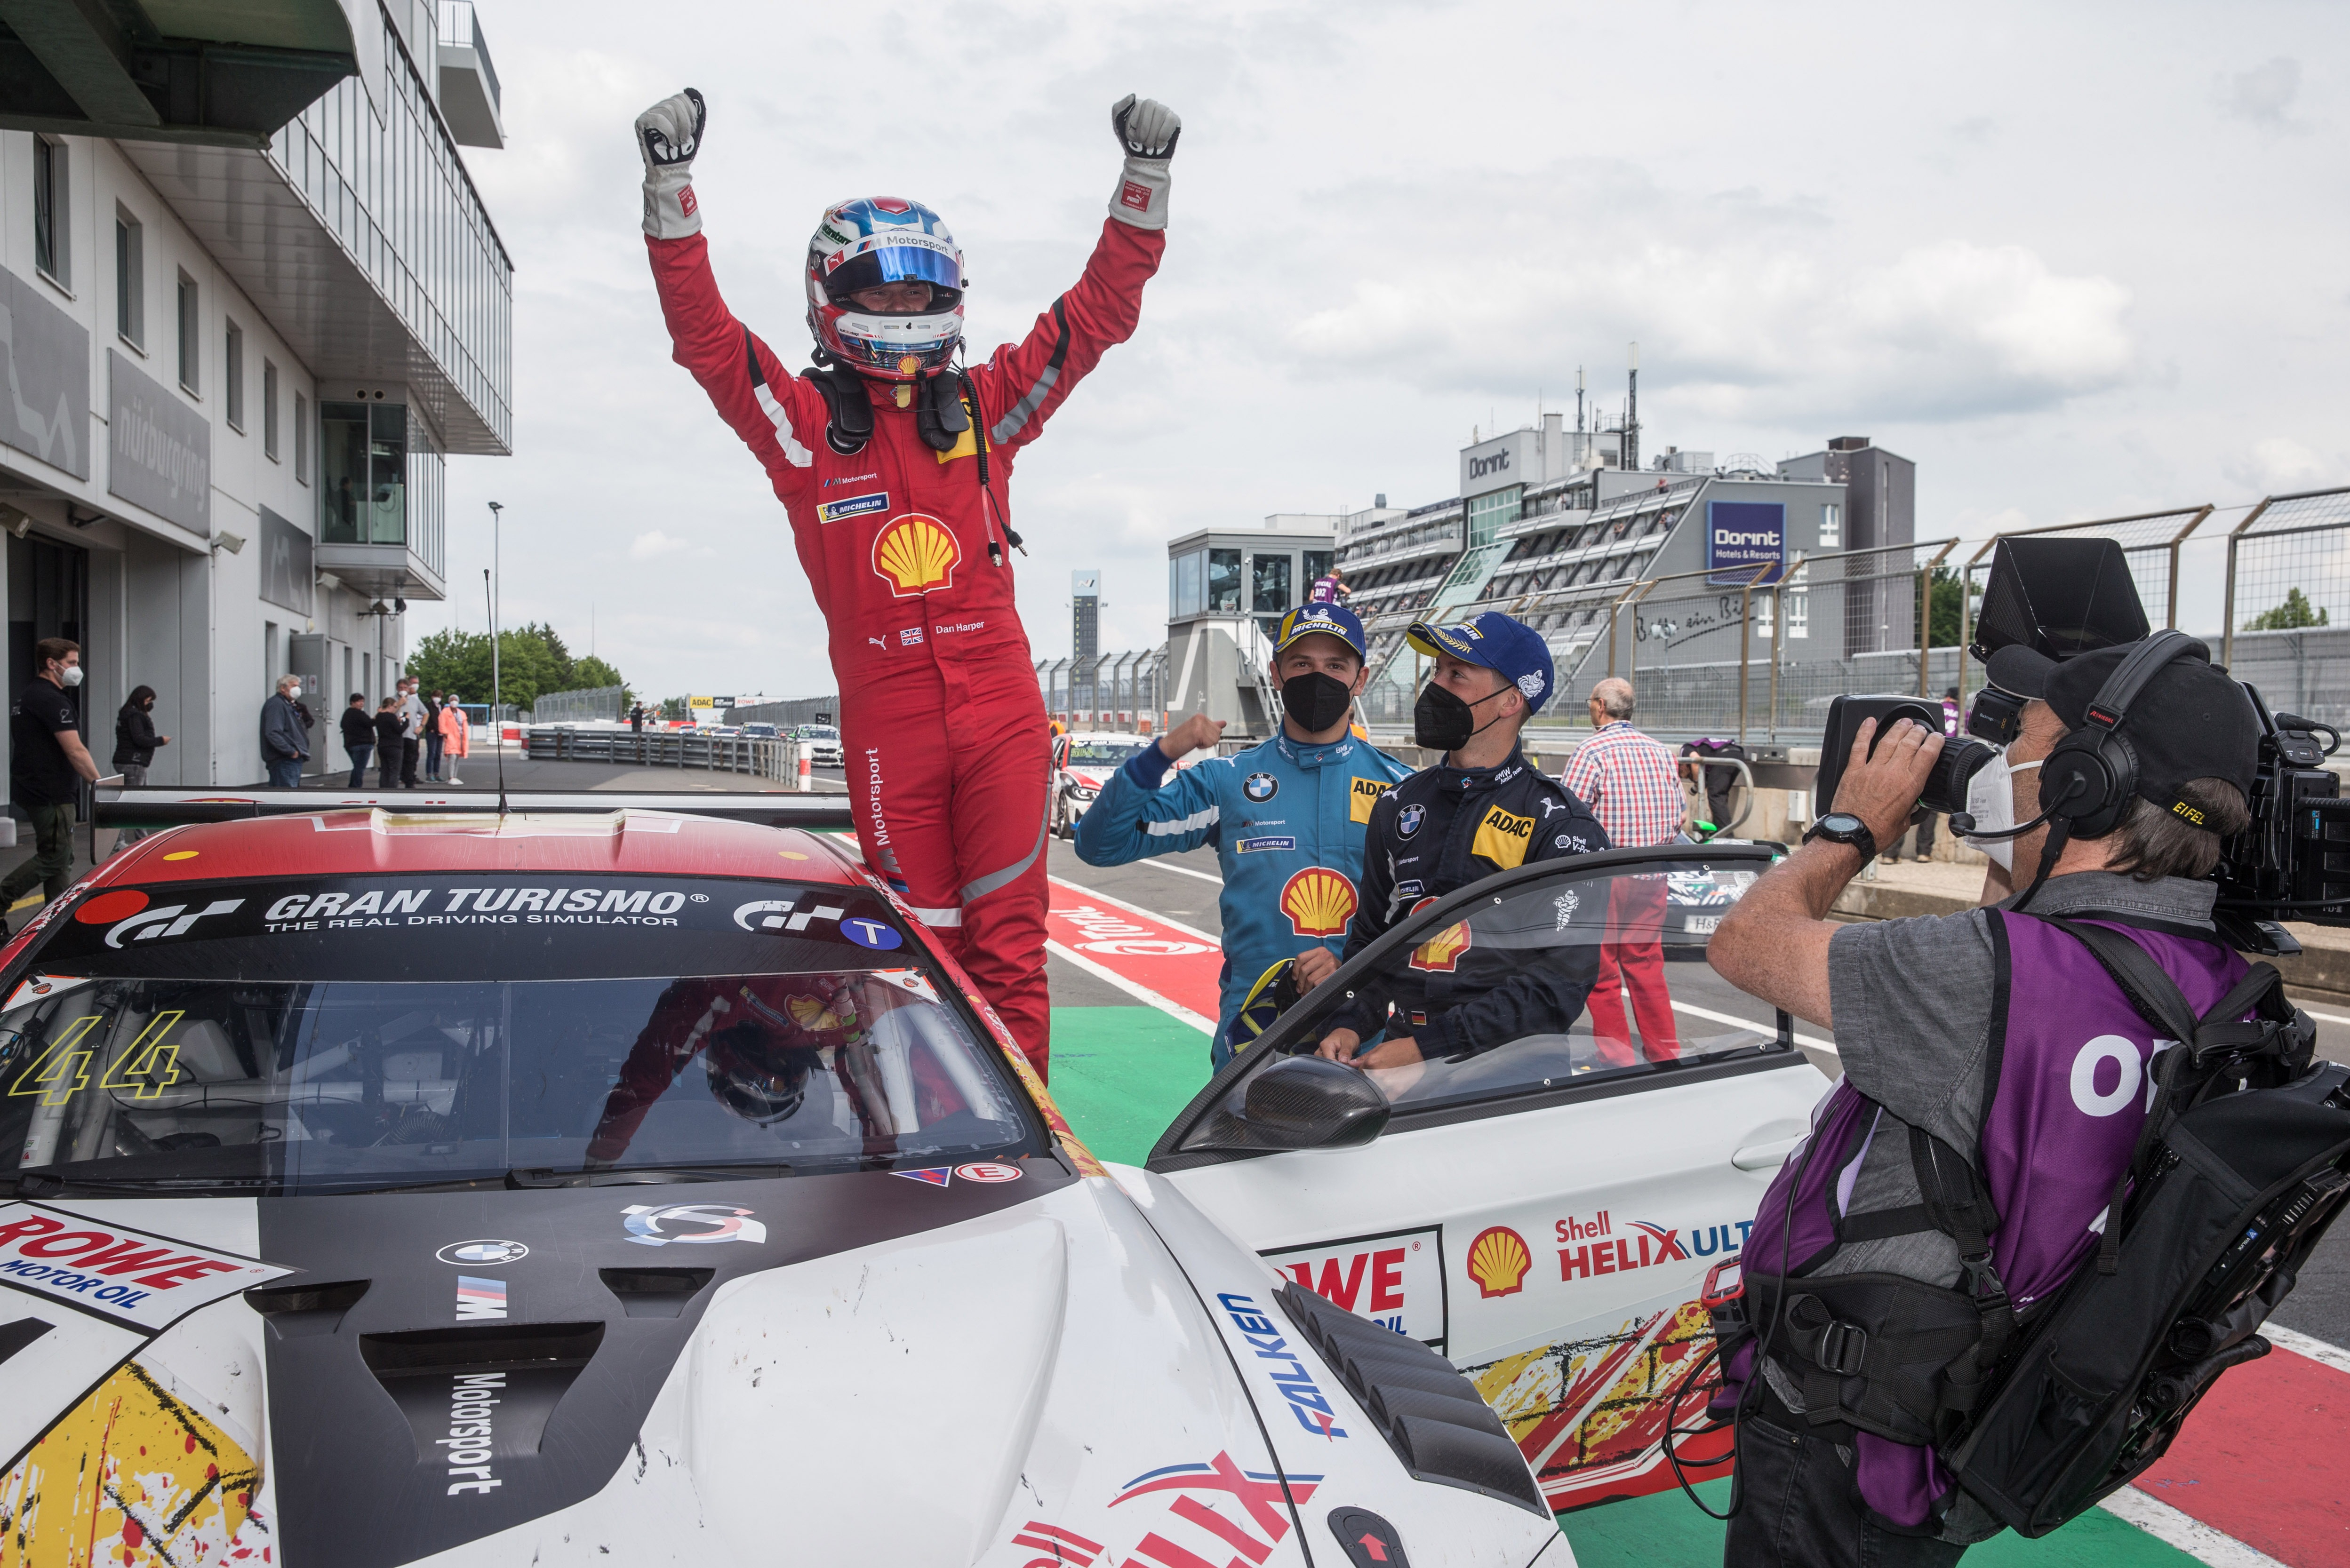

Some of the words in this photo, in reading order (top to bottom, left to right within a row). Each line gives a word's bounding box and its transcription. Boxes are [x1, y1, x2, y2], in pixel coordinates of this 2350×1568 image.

[887, 236, 949, 255] Motorsport
[119, 396, 206, 513] nürburgring
[1469, 448, 1510, 480] Dorint
[842, 472, 877, 484] Motorsport
[839, 500, 882, 513] MICHELIN
[1715, 529, 1780, 547] Dorint
[1716, 549, 1740, 559] Hotels
[1743, 550, 1748, 559] &
[1750, 550, 1780, 560] Resorts
[1719, 597, 1755, 619] Bi
[936, 624, 954, 634] Dan
[956, 620, 985, 633] Harper
[1291, 622, 1347, 636] MICHELIN
[2098, 714, 2114, 724] RIEDEL
[1071, 748, 1094, 757] 504
[1247, 773, 1276, 783] BMW
[1495, 767, 1511, 781] BMW
[1500, 774, 1513, 784] Junior
[1512, 766, 1523, 778] Team
[866, 748, 891, 846] Motorsport
[1353, 780, 1389, 799] ADA
[1399, 805, 1424, 818] BMW
[2173, 802, 2206, 825] EIFEL
[1485, 811, 1531, 838] ADAC
[1573, 836, 1586, 845] Shell
[264, 889, 432, 920] GRAN
[852, 920, 887, 945] T
[265, 920, 319, 933] THE
[328, 916, 399, 930] REAL
[408, 914, 518, 926] DRIVING
[526, 914, 678, 926] SIMULATOR
[1049, 906, 1155, 940] TOTAL
[8, 1010, 185, 1106] 44
[972, 1167, 1004, 1179] E
[1556, 1210, 1611, 1243] Shell
[0, 1214, 245, 1290] ROWE
[499, 1242, 524, 1261] BMW
[1557, 1221, 1691, 1281] HELIX
[1692, 1219, 1754, 1257] ULT
[2238, 1237, 2251, 1251] VISLINK
[0, 1260, 103, 1294] MOTOR
[94, 1282, 151, 1310] OIL
[1276, 1248, 1406, 1313] WE
[1216, 1293, 1349, 1442] FALKEN
[435, 1372, 507, 1496] Motorsport
